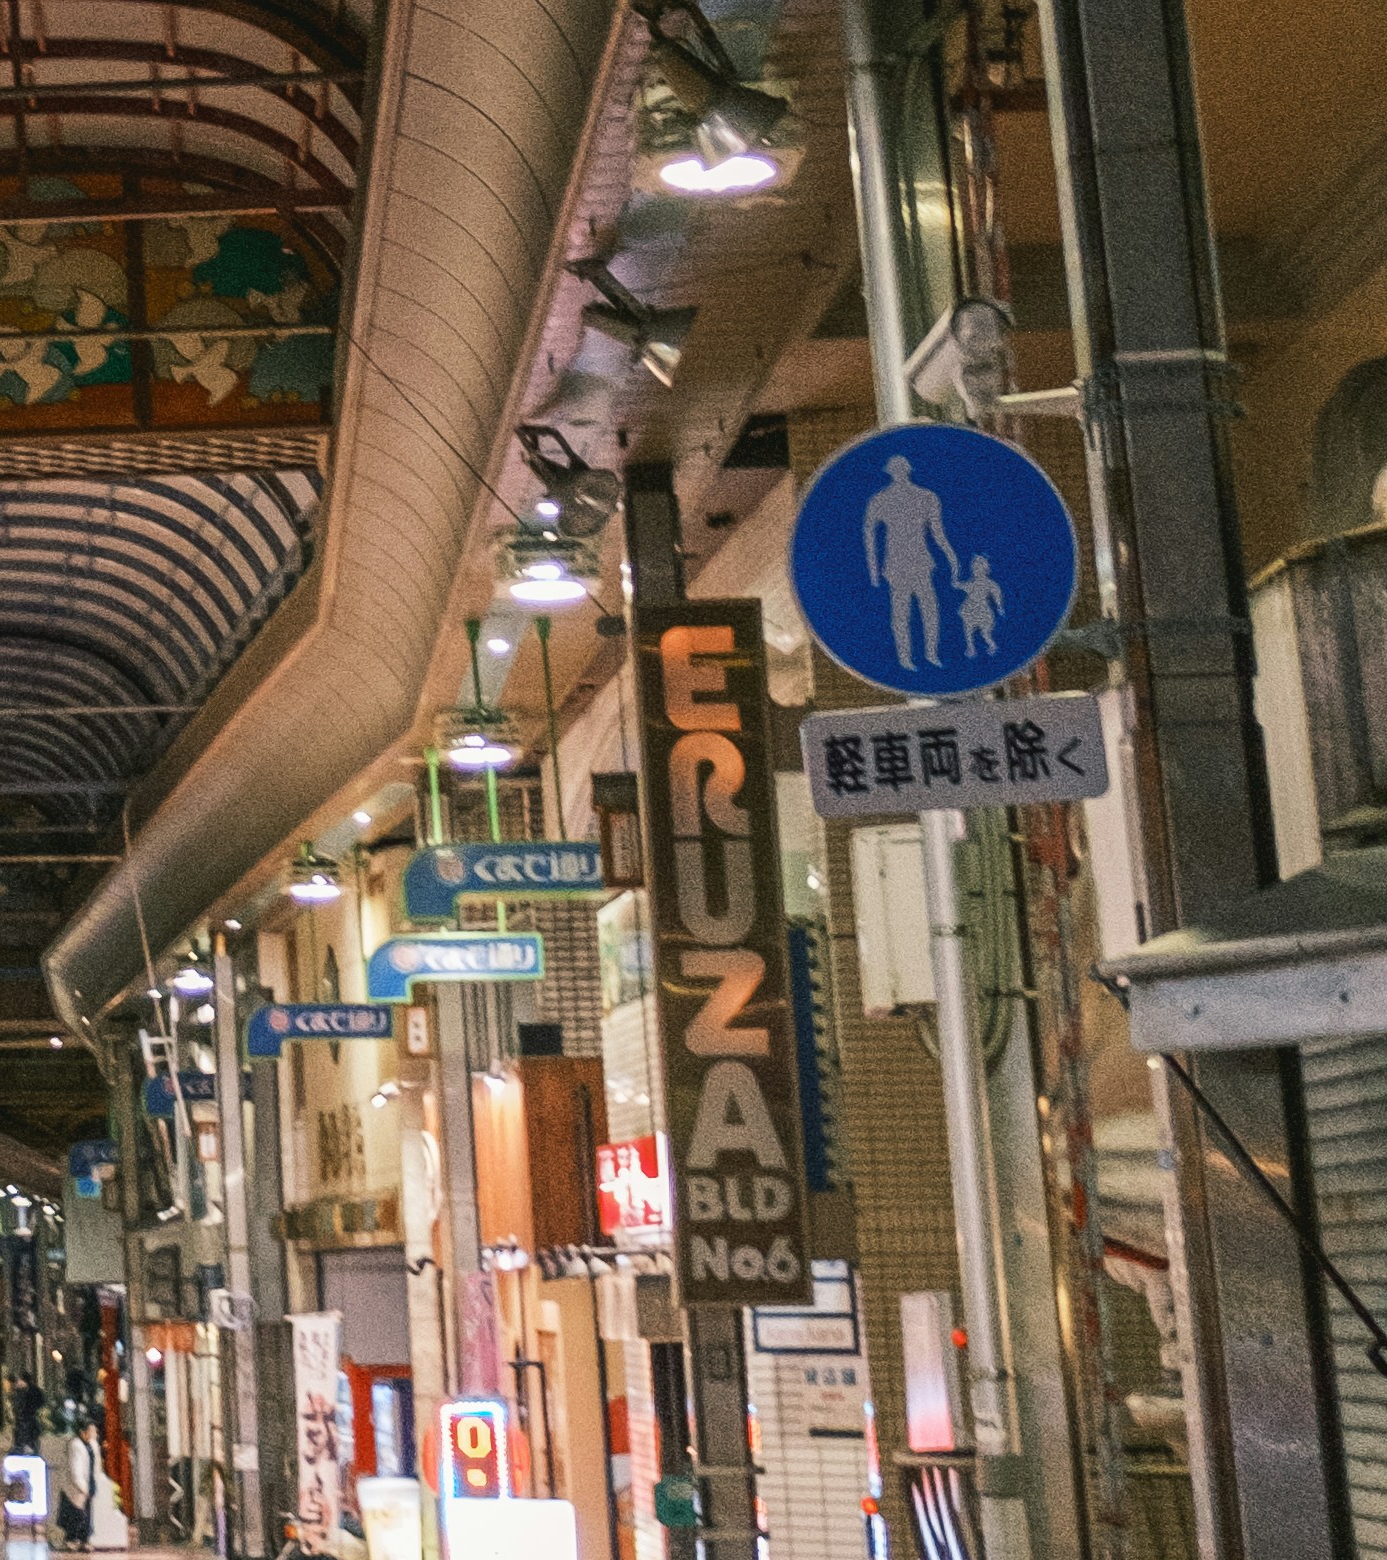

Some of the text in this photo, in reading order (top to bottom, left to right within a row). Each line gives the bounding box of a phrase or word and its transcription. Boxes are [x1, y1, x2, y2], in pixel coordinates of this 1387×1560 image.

[822, 719, 1086, 795] 軽車両を除く
[659, 625, 788, 1170] ERUZA
[688, 1176, 795, 1222] BLD
